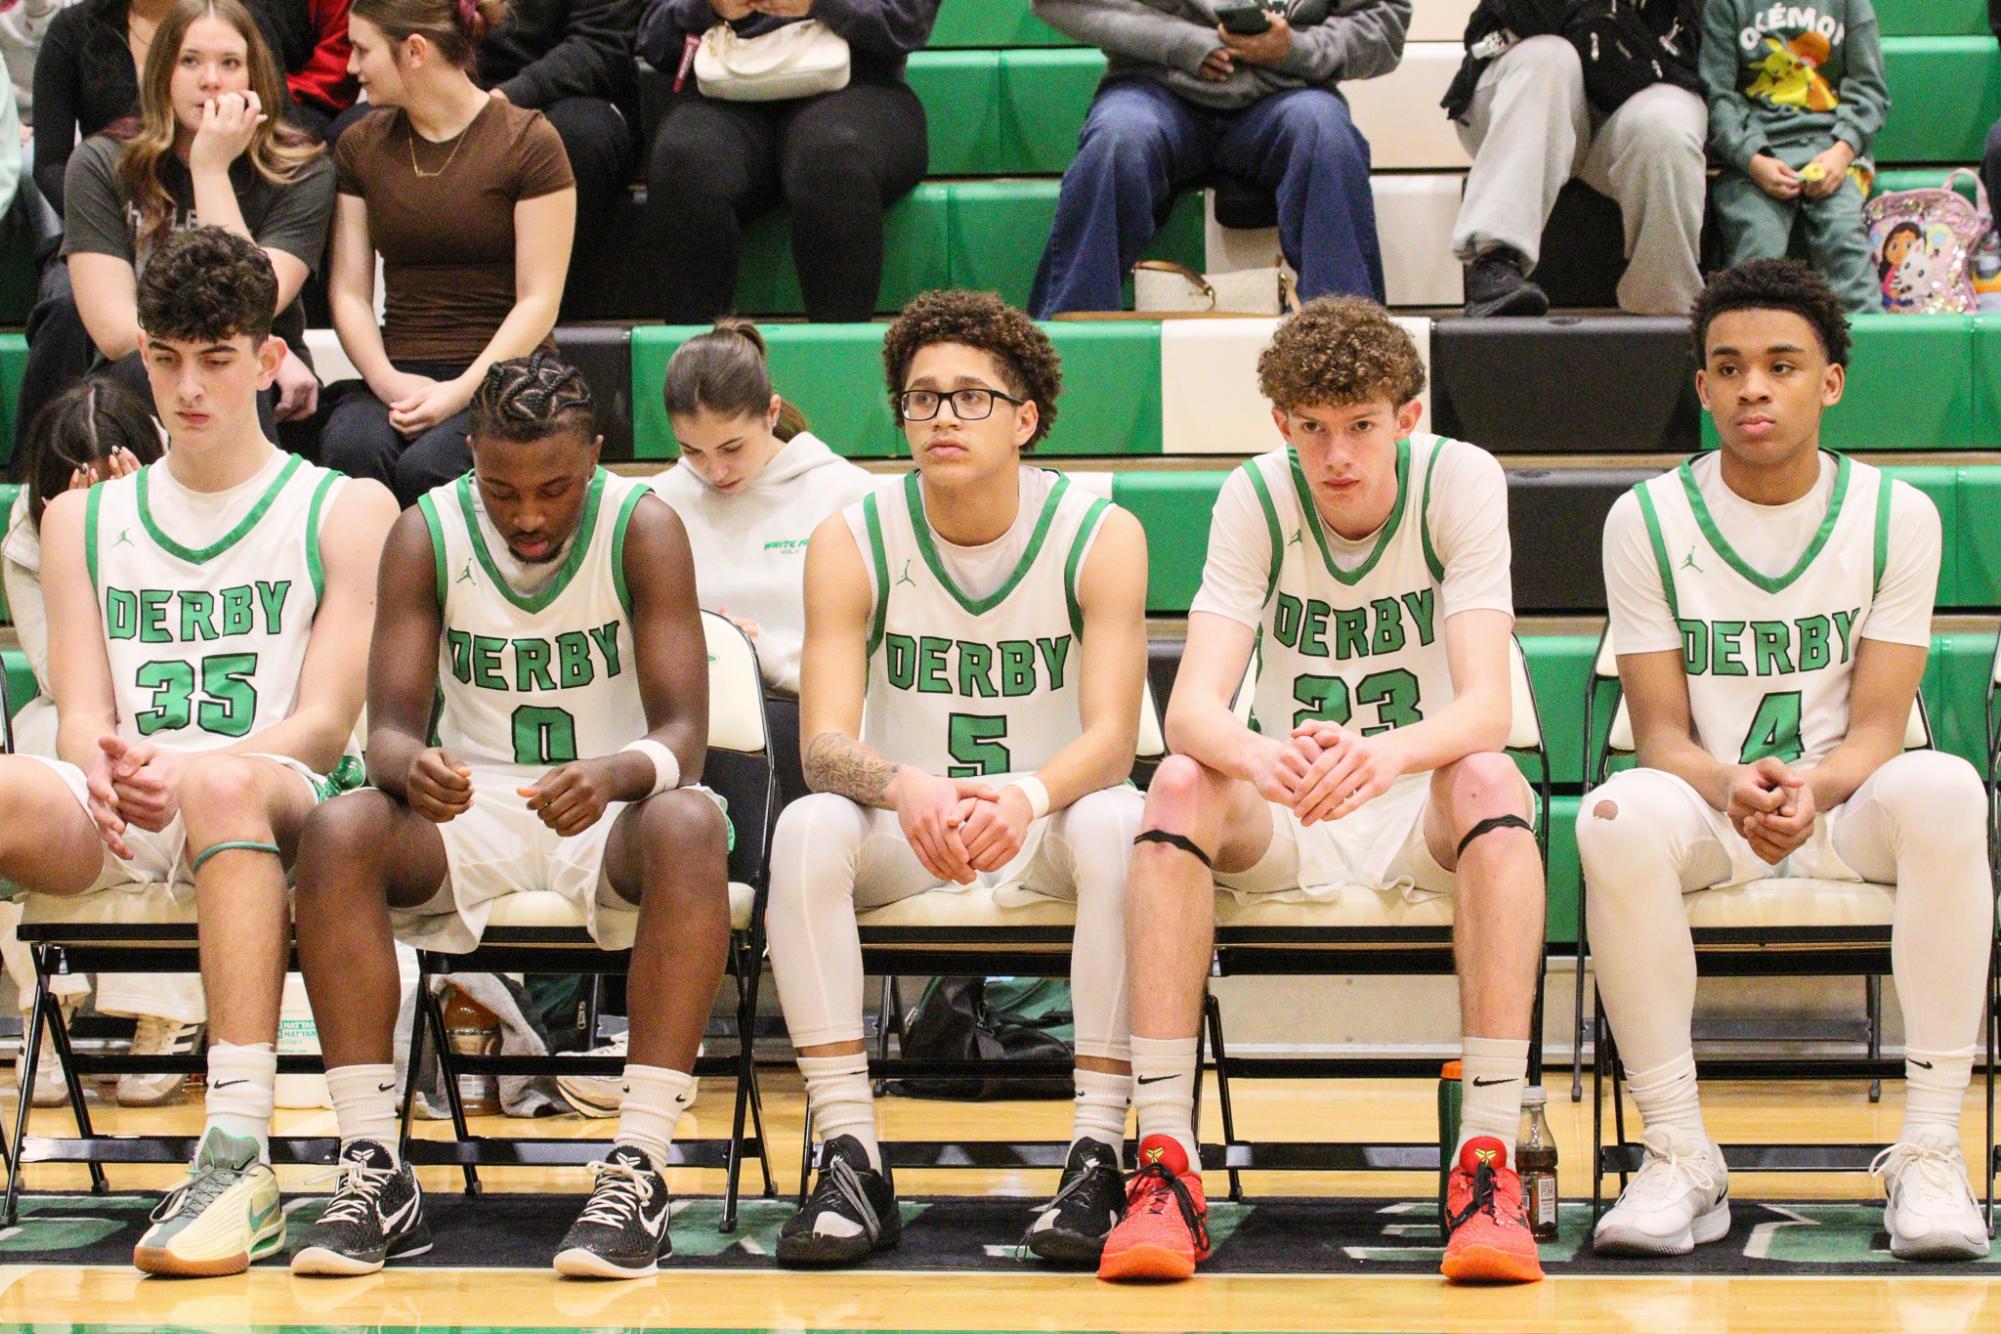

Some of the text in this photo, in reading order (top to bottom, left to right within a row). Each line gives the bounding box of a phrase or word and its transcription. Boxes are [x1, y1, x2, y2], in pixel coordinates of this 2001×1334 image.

[107, 580, 292, 643] DERBY
[1274, 587, 1435, 660] DERBY
[1679, 607, 1861, 676] DERBY
[447, 620, 621, 692] DERBY
[886, 632, 1072, 697] DERBY
[135, 652, 258, 738] 35
[1293, 668, 1424, 737] 23
[1738, 690, 1806, 764] 4
[511, 704, 578, 766] 0
[948, 712, 1011, 778] 5
